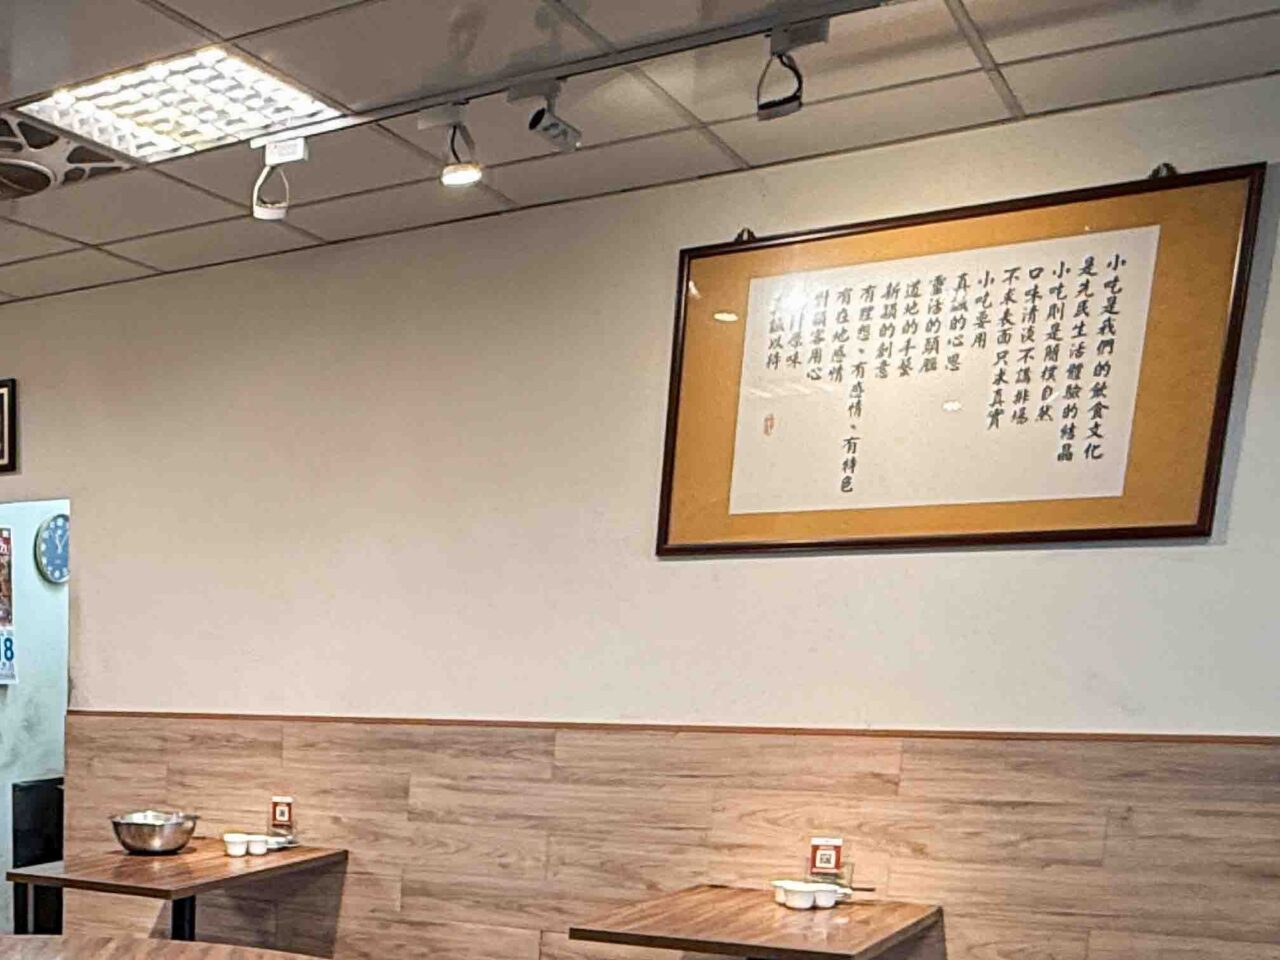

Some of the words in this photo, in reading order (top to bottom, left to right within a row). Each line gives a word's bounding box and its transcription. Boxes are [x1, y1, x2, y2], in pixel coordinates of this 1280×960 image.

[970, 270, 995, 349] 小吃要用
[987, 266, 1021, 430] 不求表面只求真實
[1057, 255, 1098, 461] 是先民生活體驗的結晶
[1083, 253, 1127, 460] 小吃是我們的飲食文化
